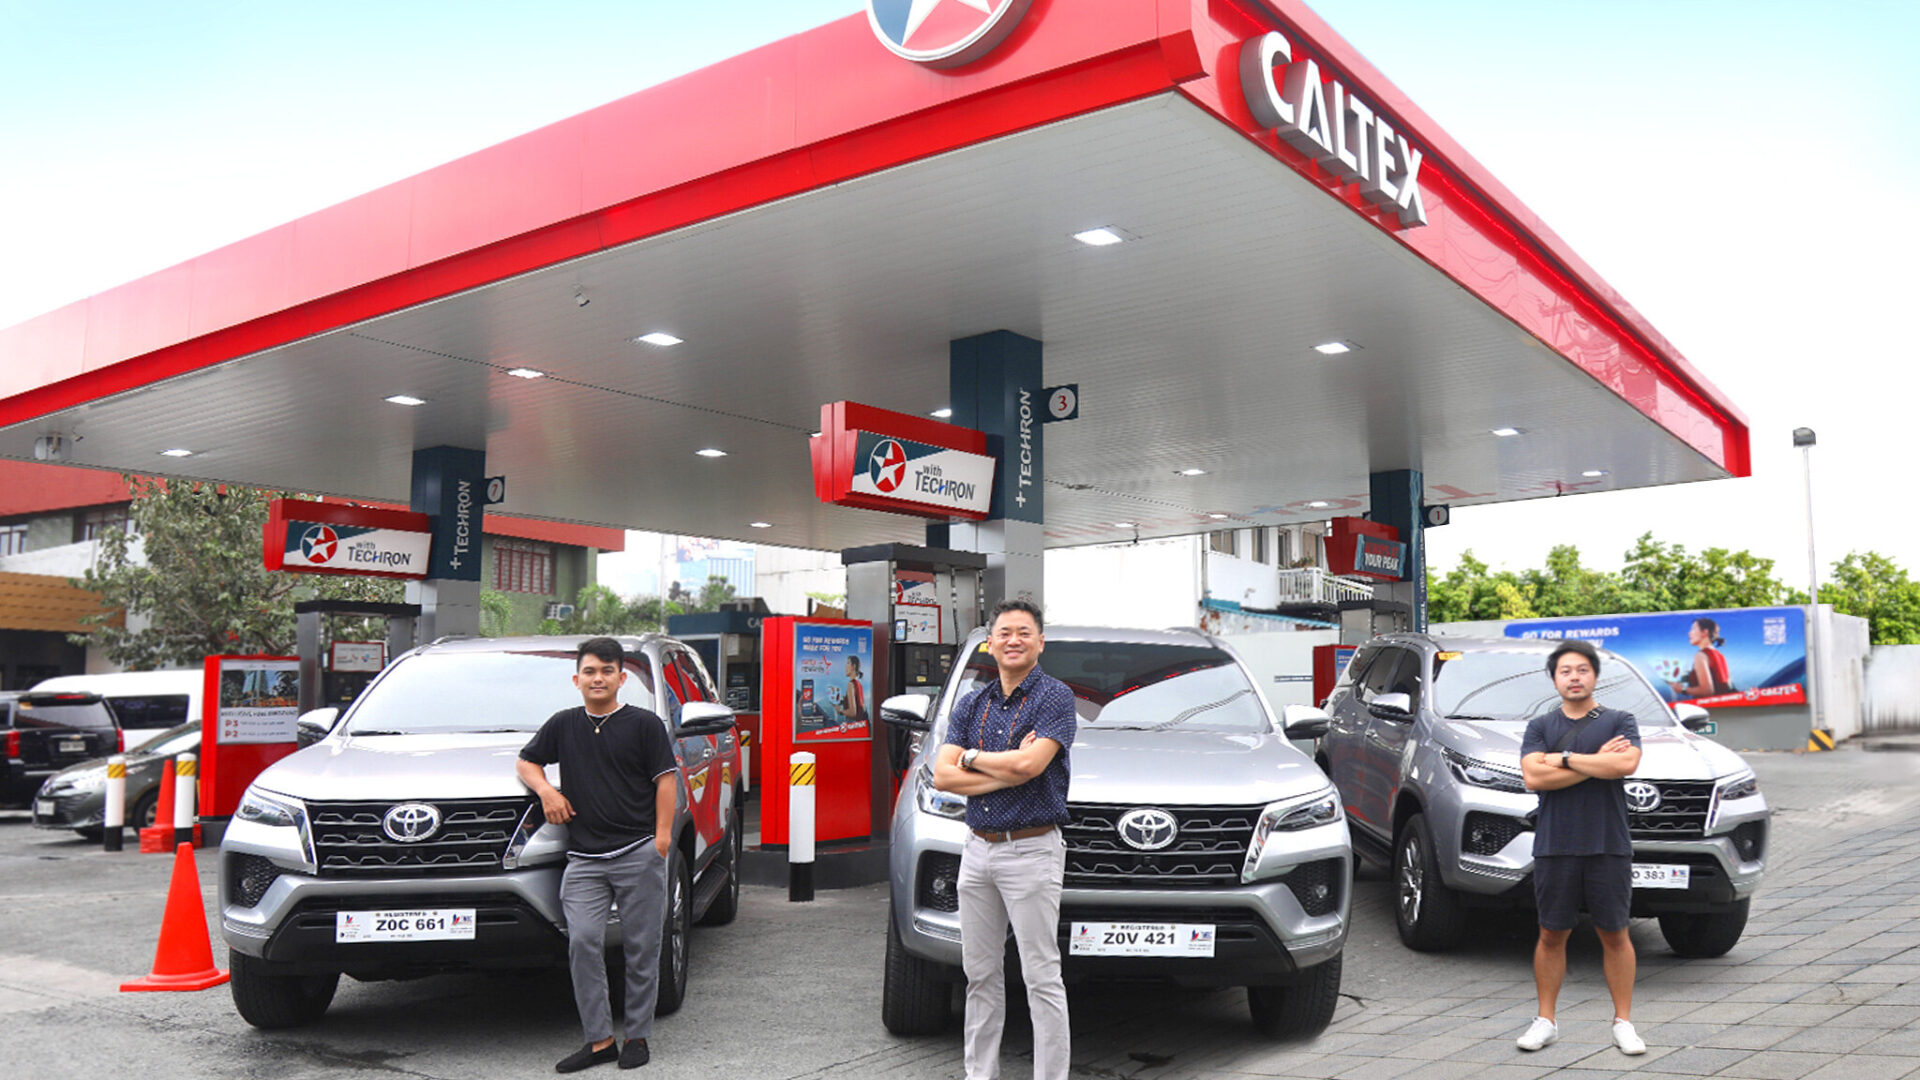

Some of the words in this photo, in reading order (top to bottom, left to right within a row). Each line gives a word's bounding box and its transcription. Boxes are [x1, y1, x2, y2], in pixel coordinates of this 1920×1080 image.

[1240, 31, 1428, 226] CALTEX
[1057, 395, 1067, 411] 3
[923, 464, 943, 477] with
[491, 484, 499, 497] 7
[915, 470, 976, 502] TECHRON
[356, 541, 376, 549] with
[347, 546, 412, 567] TECHRON
[1364, 552, 1382, 569] YOUR
[1382, 556, 1399, 571] PEAK
[1541, 630, 1562, 639] FOR
[1565, 626, 1619, 638] REWARDS
[1644, 870, 1665, 880] 383
[415, 918, 445, 931] 661
[1144, 932, 1176, 945] 421
